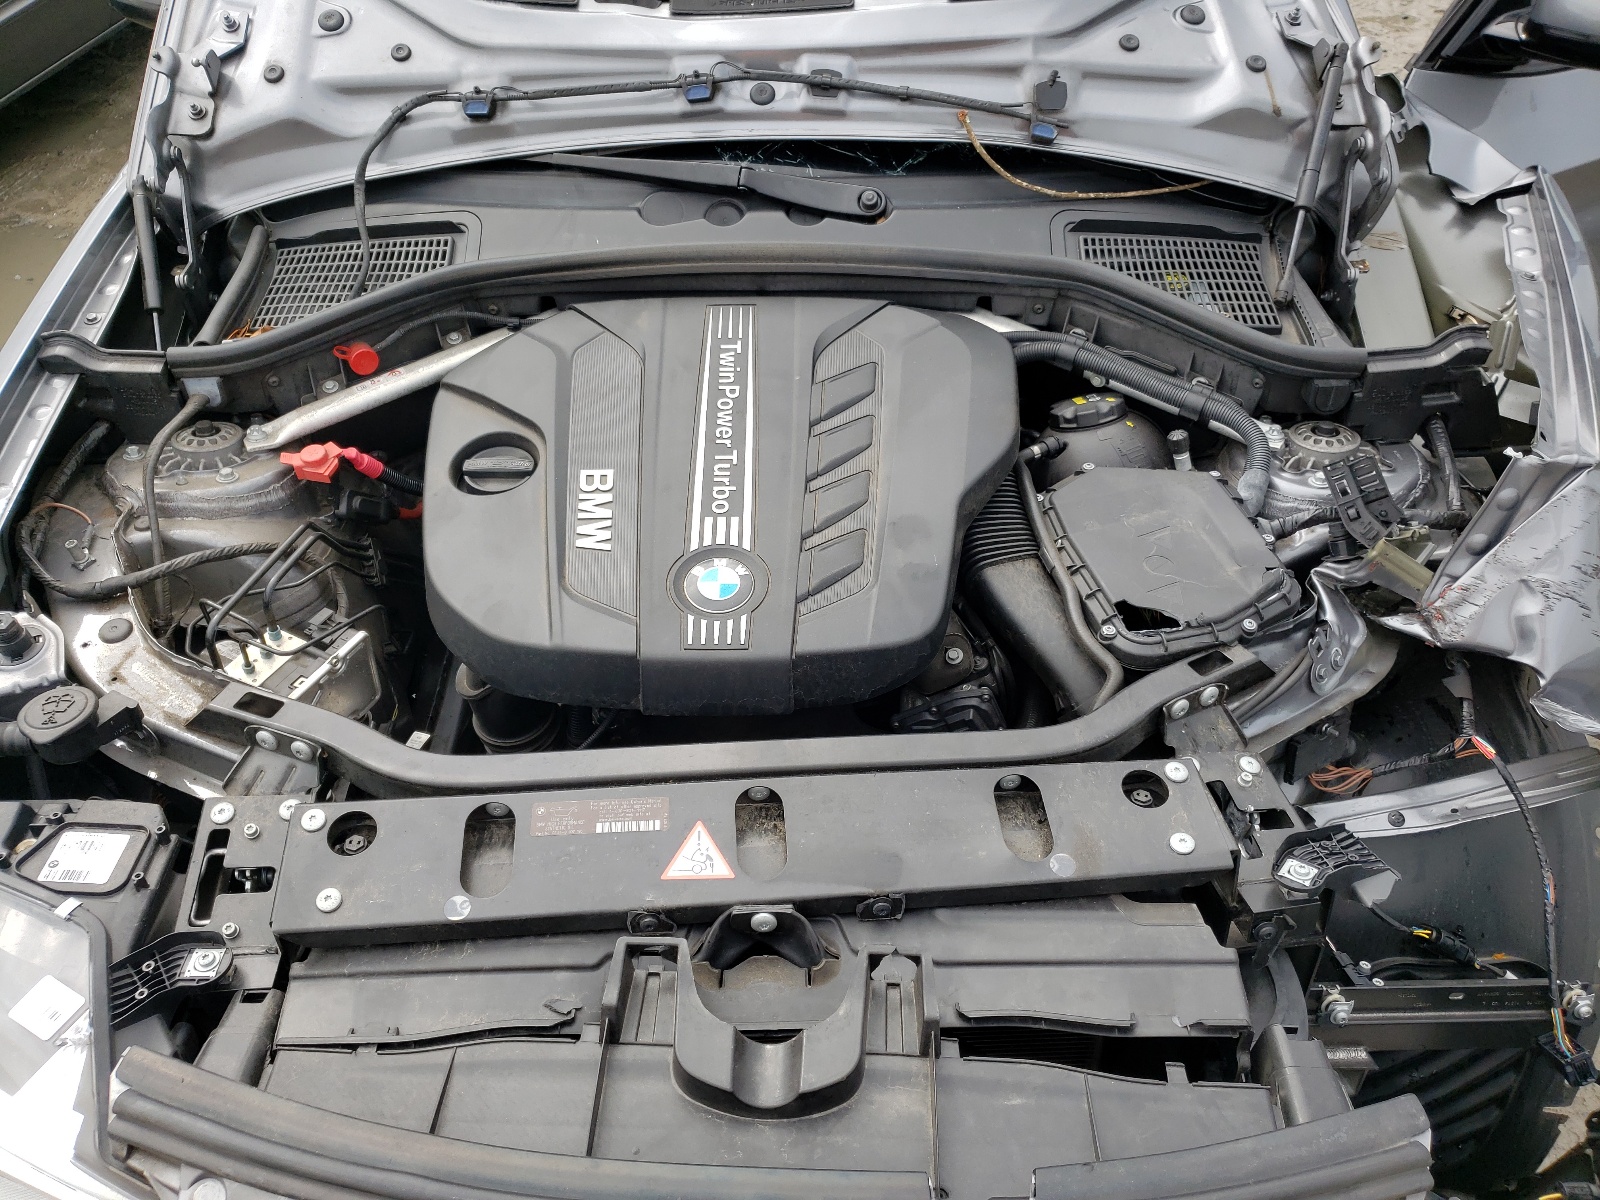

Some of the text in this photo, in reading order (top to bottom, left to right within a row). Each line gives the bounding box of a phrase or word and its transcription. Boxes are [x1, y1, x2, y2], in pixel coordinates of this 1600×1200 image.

[711, 340, 742, 514] TwinPower Turbo
[575, 469, 614, 552] BMW
[690, 557, 750, 577] BMW
